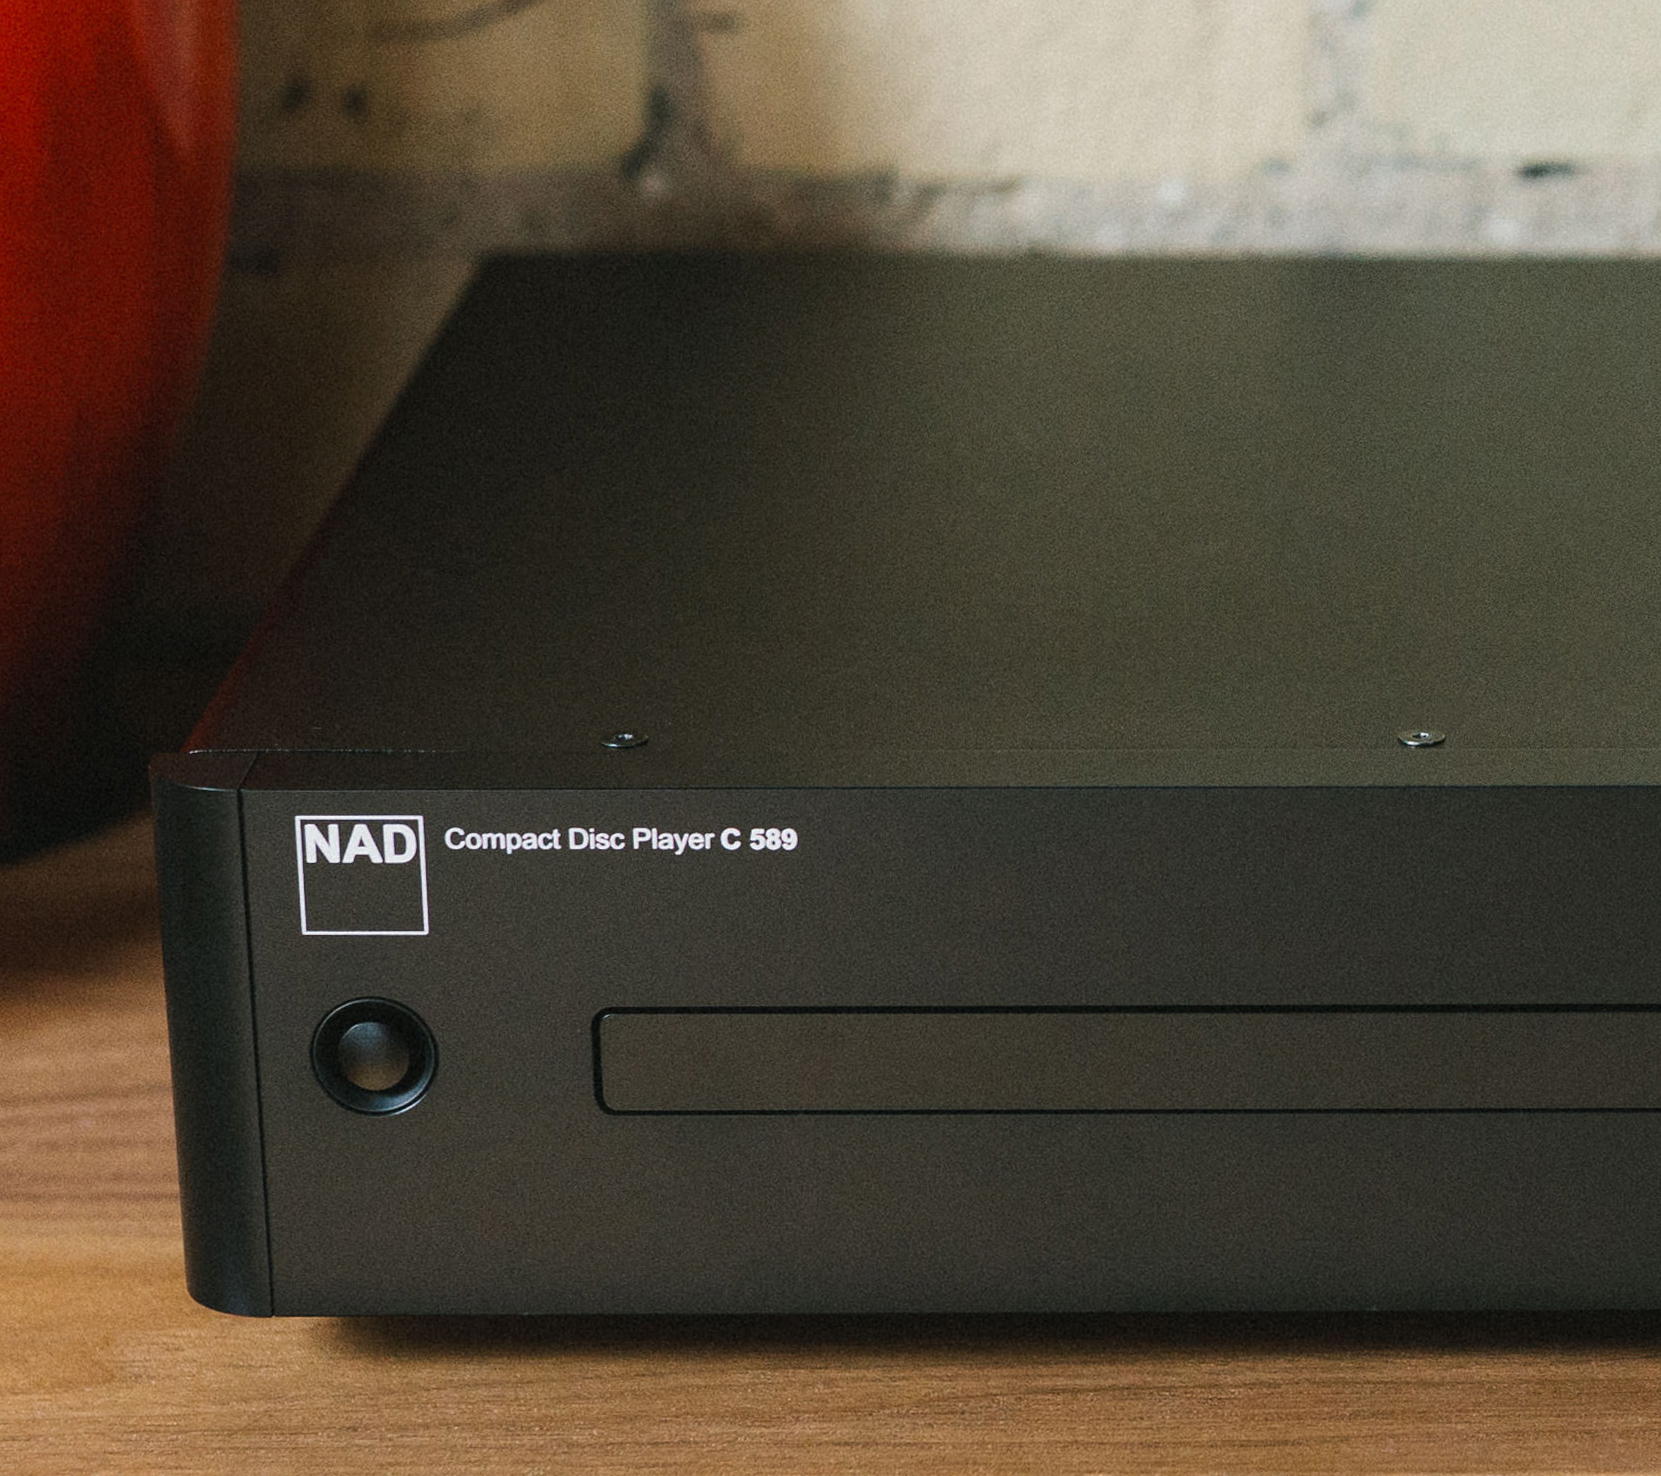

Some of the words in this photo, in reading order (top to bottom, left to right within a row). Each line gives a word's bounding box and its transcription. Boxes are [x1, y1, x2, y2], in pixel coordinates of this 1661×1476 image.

[304, 822, 418, 866] NAD
[444, 827, 562, 855] Compact
[568, 827, 626, 850] Disc
[632, 827, 716, 856] Player
[720, 827, 742, 851] C
[750, 828, 798, 851] 589
